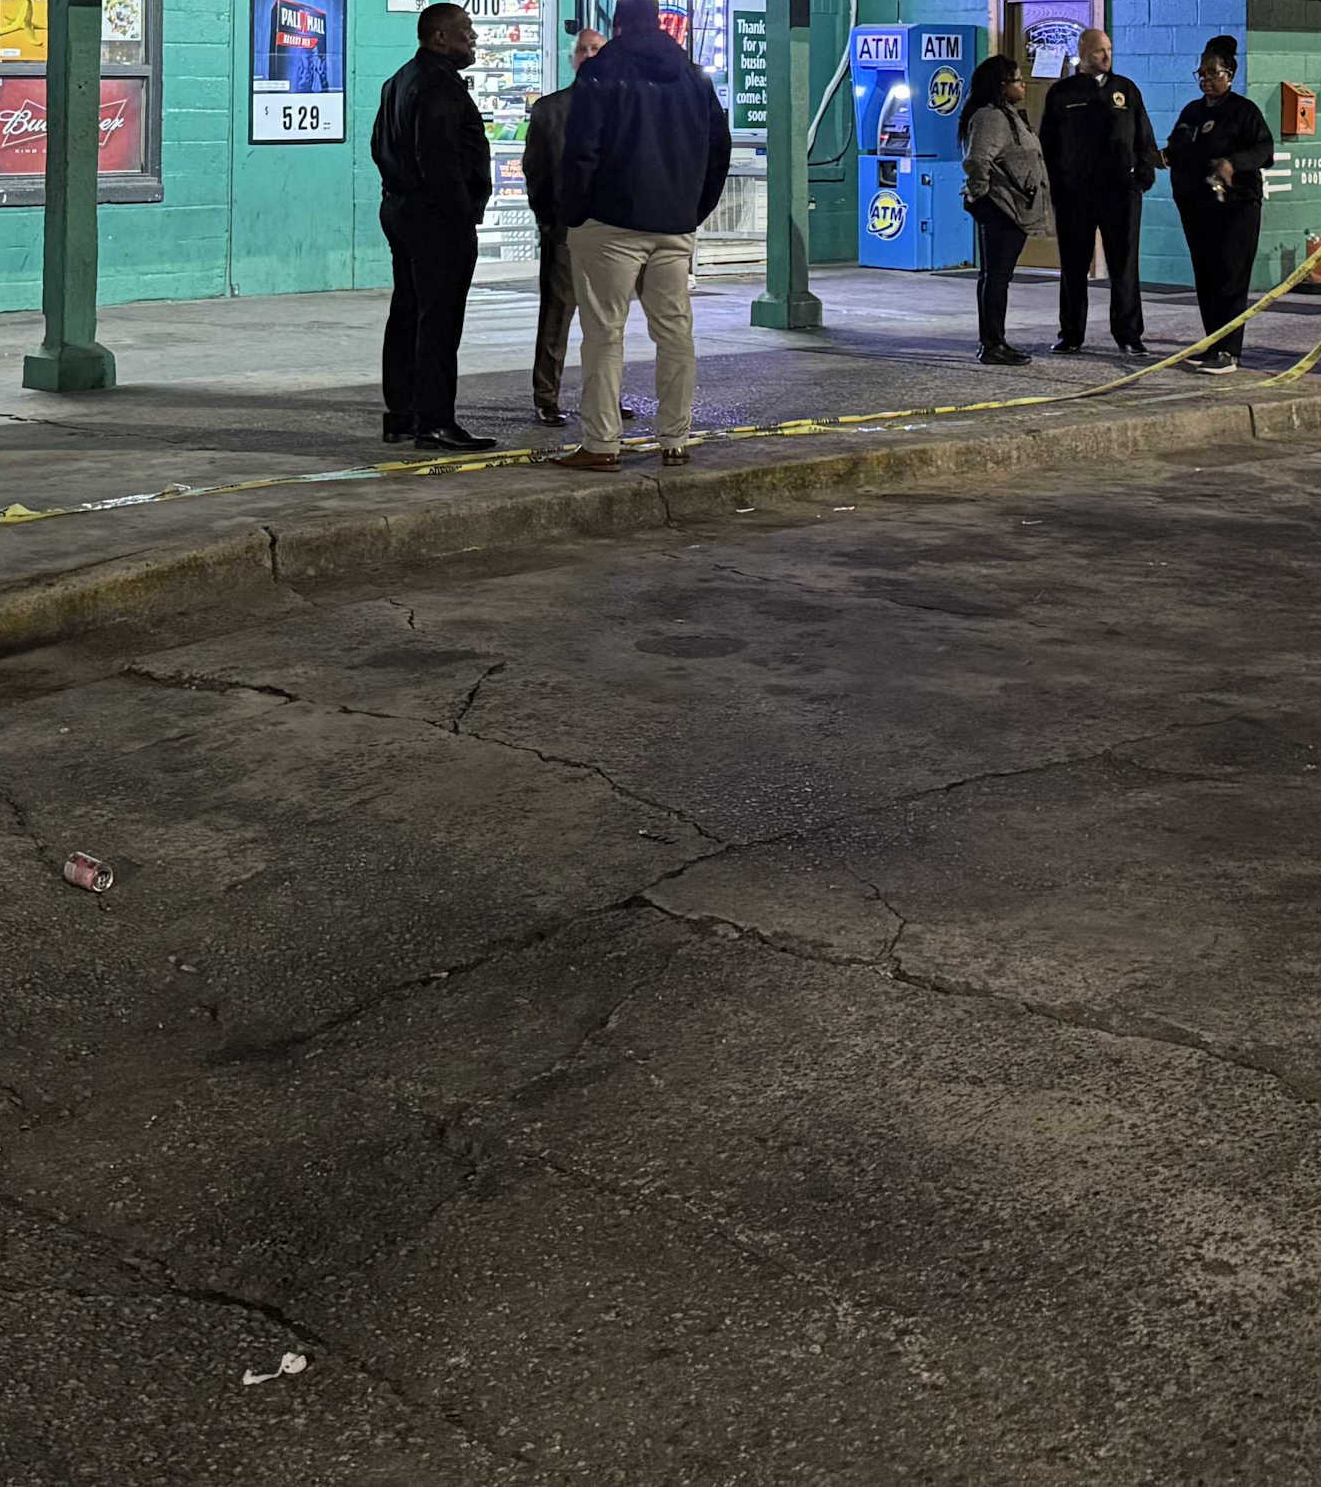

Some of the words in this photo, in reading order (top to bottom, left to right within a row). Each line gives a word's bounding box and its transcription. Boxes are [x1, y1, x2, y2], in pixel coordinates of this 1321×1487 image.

[281, 7, 300, 28] PALL
[307, 16, 325, 34] MALL
[736, 18, 766, 35] Thank
[743, 36, 757, 52] for
[859, 37, 900, 60] ATM
[924, 36, 959, 58] ATM
[741, 54, 767, 70] busin
[745, 71, 767, 90] plea
[736, 92, 762, 105] come
[930, 84, 961, 99] ATM
[870, 206, 904, 222] ATM
